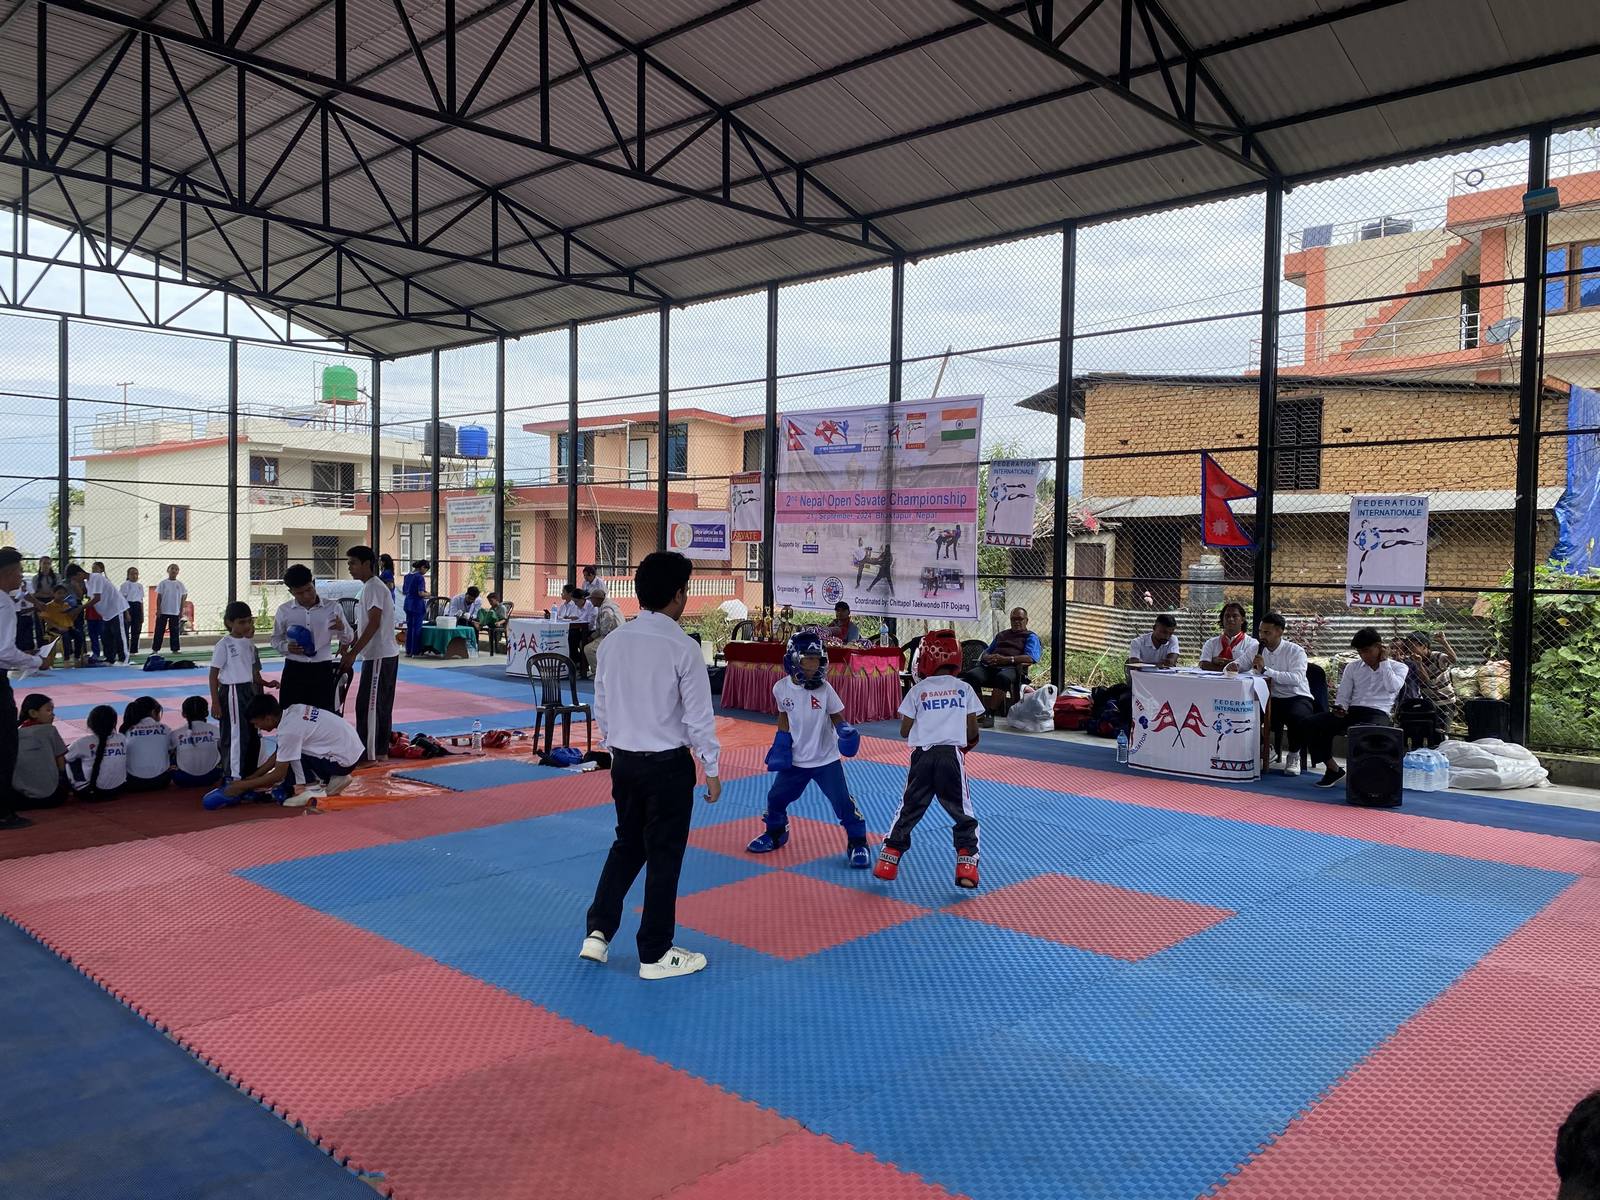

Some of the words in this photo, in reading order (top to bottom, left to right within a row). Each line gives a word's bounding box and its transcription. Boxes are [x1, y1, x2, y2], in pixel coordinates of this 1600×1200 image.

[800, 494, 825, 509] Nepal
[827, 494, 851, 509] Open
[854, 493, 886, 507] Savate
[889, 491, 967, 509] Championship
[1357, 499, 1424, 507] FEDERATION
[916, 511, 937, 521] Nepal
[1357, 508, 1422, 517] INTERNATIONALE
[987, 534, 1031, 547] SAVATE
[855, 597, 883, 606] Coordinated
[912, 600, 940, 609] Taekwondo
[950, 602, 970, 612] Dojang
[1351, 592, 1422, 607] SAVATE
[929, 689, 957, 698] SAVATE
[922, 698, 965, 711] NEPAL
[130, 728, 167, 737] NEPAL
[179, 735, 215, 746] NEPAL
